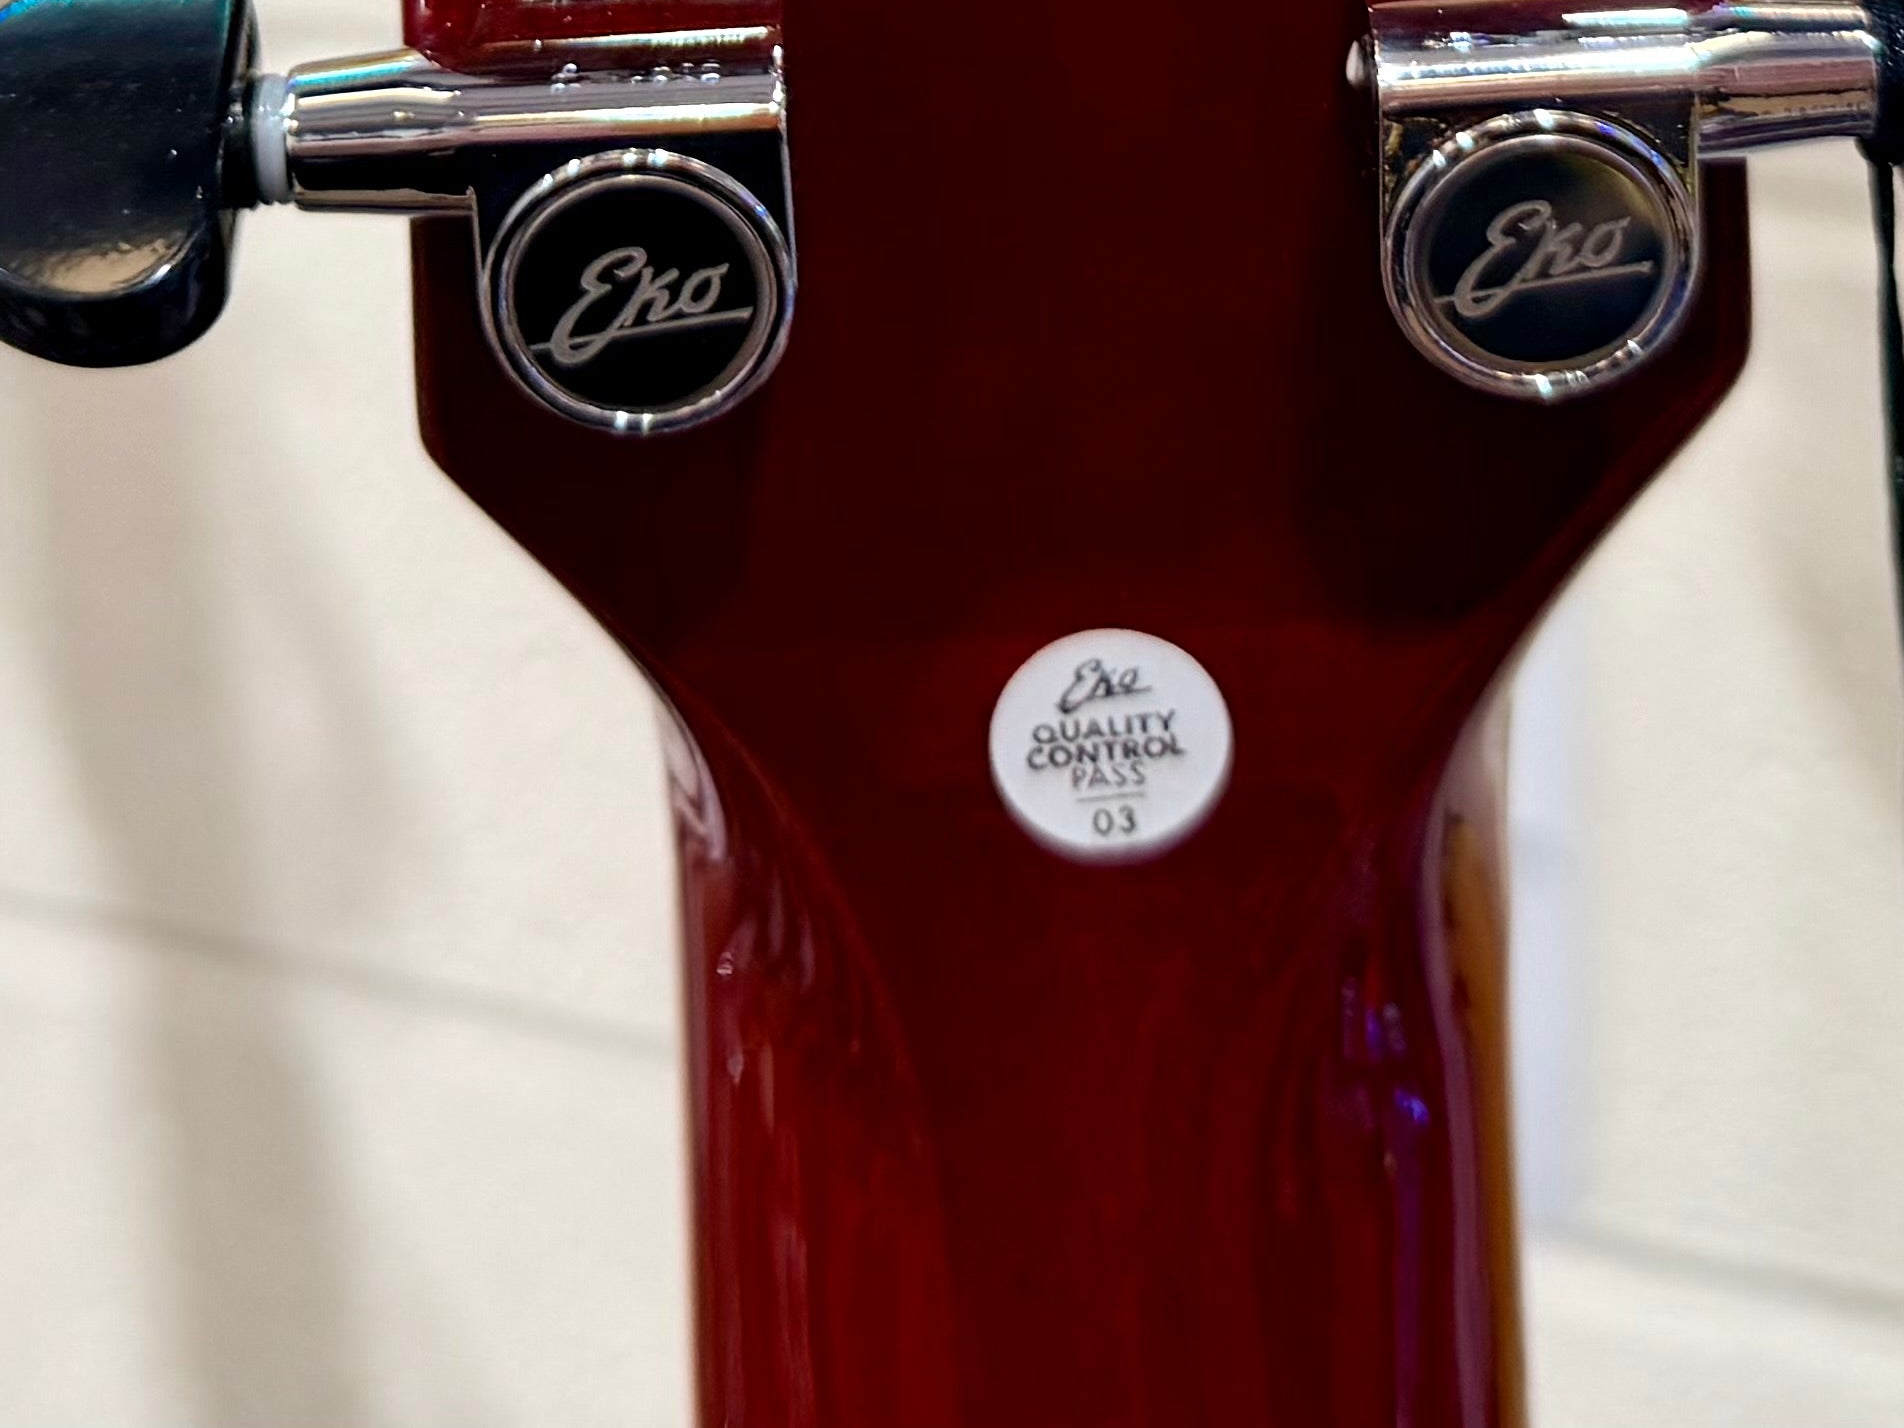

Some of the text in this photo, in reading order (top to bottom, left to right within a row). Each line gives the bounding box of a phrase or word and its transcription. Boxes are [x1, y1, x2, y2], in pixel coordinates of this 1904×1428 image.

[1433, 199, 1654, 319] Eko
[529, 246, 753, 367] Eko
[1056, 657, 1153, 714] Eko
[1032, 708, 1176, 746] QUALITY
[1026, 733, 1187, 771] CONTROL
[1071, 760, 1149, 789] PASS
[1092, 804, 1138, 838] 03
